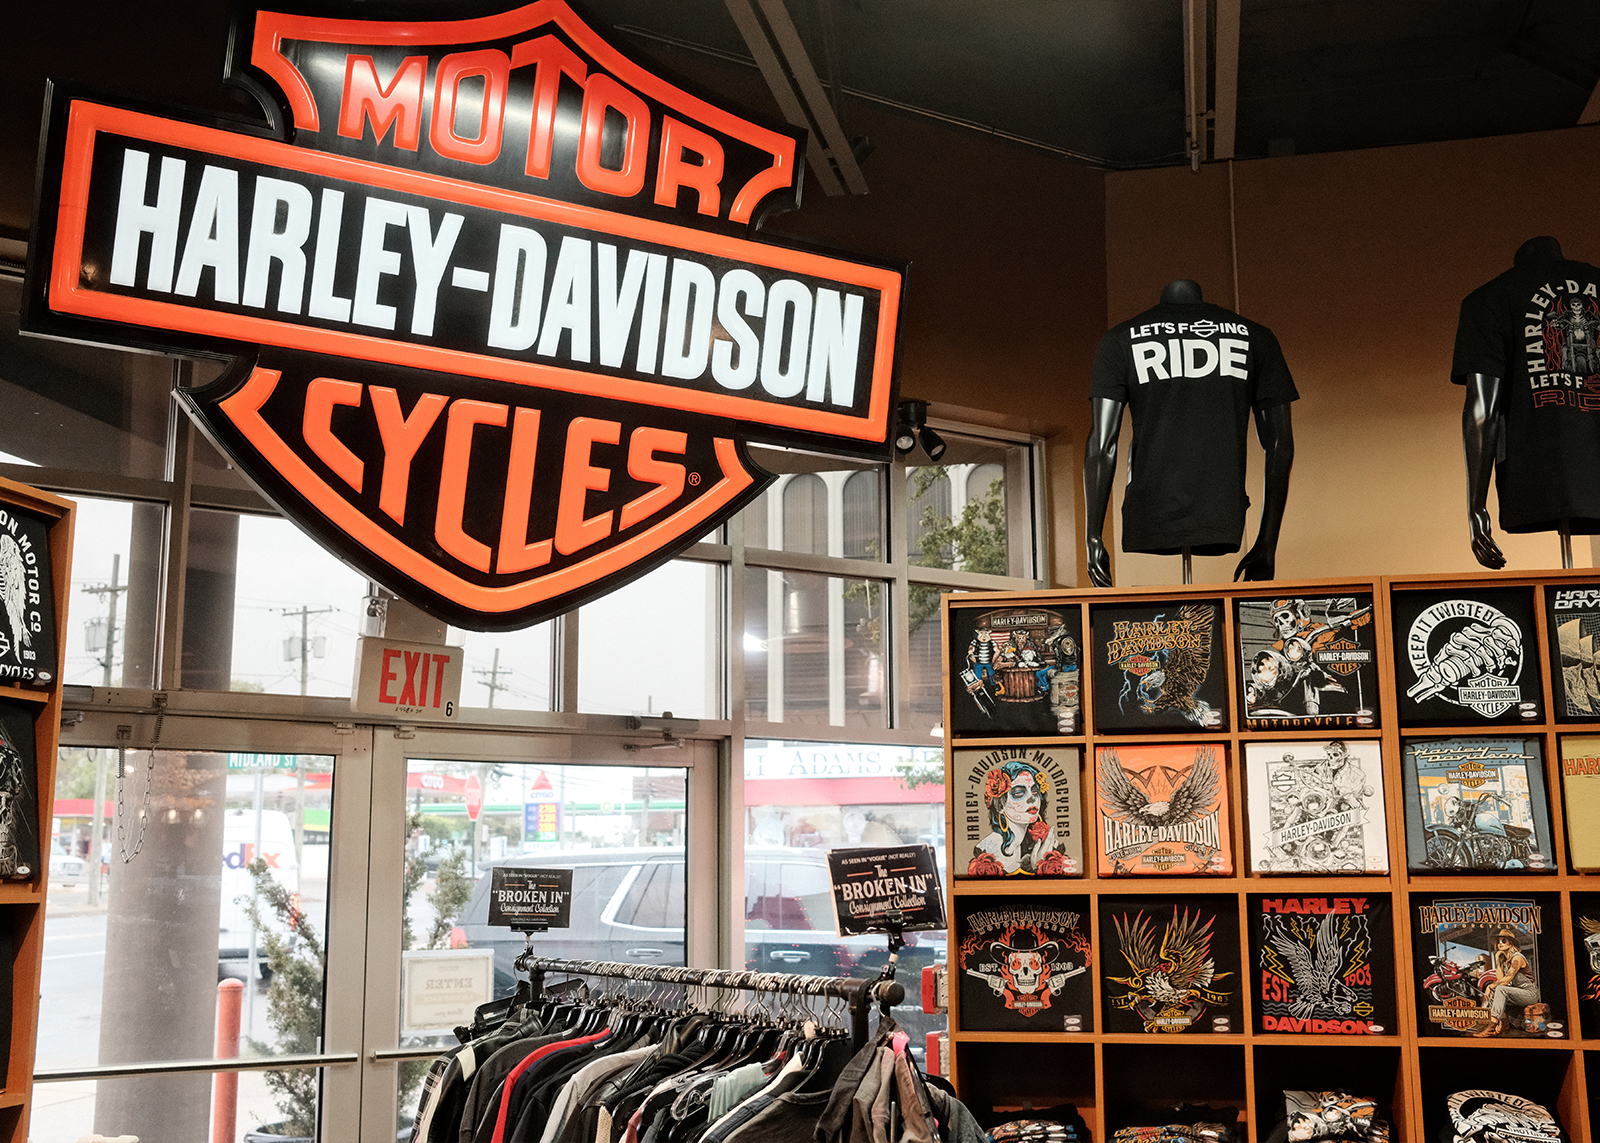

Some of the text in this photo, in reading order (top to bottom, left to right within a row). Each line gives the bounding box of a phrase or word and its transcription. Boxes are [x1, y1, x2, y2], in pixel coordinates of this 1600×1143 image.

[337, 34, 725, 217] MOTOR
[110, 148, 865, 408] HARLEY-DAVIDSON
[1130, 322, 1176, 339] LET'S
[1131, 338, 1250, 385] RIDE
[1529, 373, 1572, 390] LET'S
[303, 377, 687, 575] CYCLES
[18, 534, 40, 606] MOTOR
[1113, 621, 1199, 641] HARLEY-
[1411, 602, 1495, 671] KEEP IT TWISTED
[1106, 634, 1202, 665] DAVIDSON
[1330, 640, 1357, 650] MOTOR
[1318, 651, 1369, 661] HARLEY-DAVIDSON
[1330, 662, 1358, 674] CYCLES
[379, 649, 450, 708] EXIT
[1474, 677, 1503, 688] MOTOR
[1463, 689, 1517, 700] HARLEY-DAVIDSON
[445, 701, 453, 717] 6
[1477, 702, 1505, 714] CYCLES
[1246, 717, 1362, 729] MOTORCYCLE
[788, 750, 881, 775] ADAMS
[1563, 757, 1600, 776] HAR
[1103, 810, 1221, 856] HARLEY-DAVIDSON
[1280, 811, 1352, 843] HARLEY-DAVIDSON
[874, 865, 888, 877] The
[500, 903, 534, 916] Consignment
[849, 894, 927, 917] Consignment Collection
[1262, 897, 1370, 914] HARLEY-
[1418, 905, 1542, 935] HARLEY-DAVIDSON
[1262, 963, 1372, 1003] EST. 1903
[1432, 1009, 1489, 1019] HARLEY-DAVIDSON
[1262, 1015, 1374, 1035] DAVIDSON
